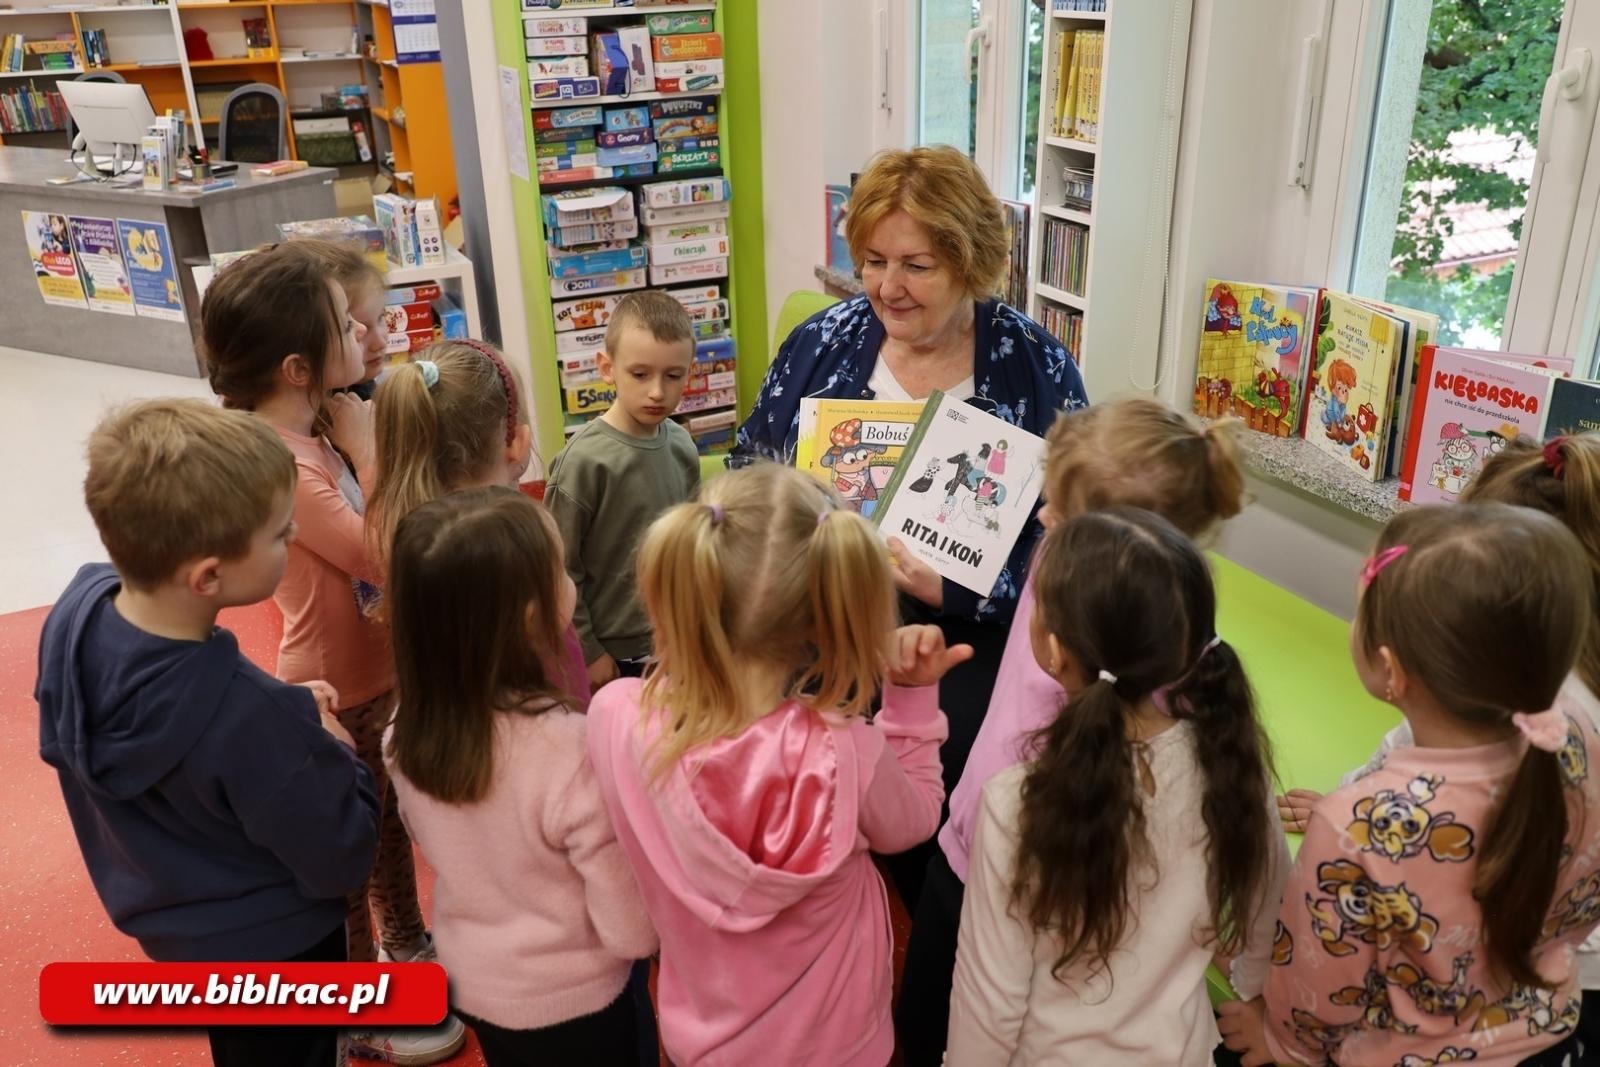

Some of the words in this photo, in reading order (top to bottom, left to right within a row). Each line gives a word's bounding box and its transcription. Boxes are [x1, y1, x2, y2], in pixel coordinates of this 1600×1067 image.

[556, 307, 572, 321] KOT
[1434, 370, 1539, 414] KIEŁBASKA
[1485, 410, 1520, 424] przedszkola
[865, 425, 910, 441] Bobuś
[901, 518, 939, 547] RITA
[939, 536, 949, 551] I
[947, 539, 983, 568] KOŃ
